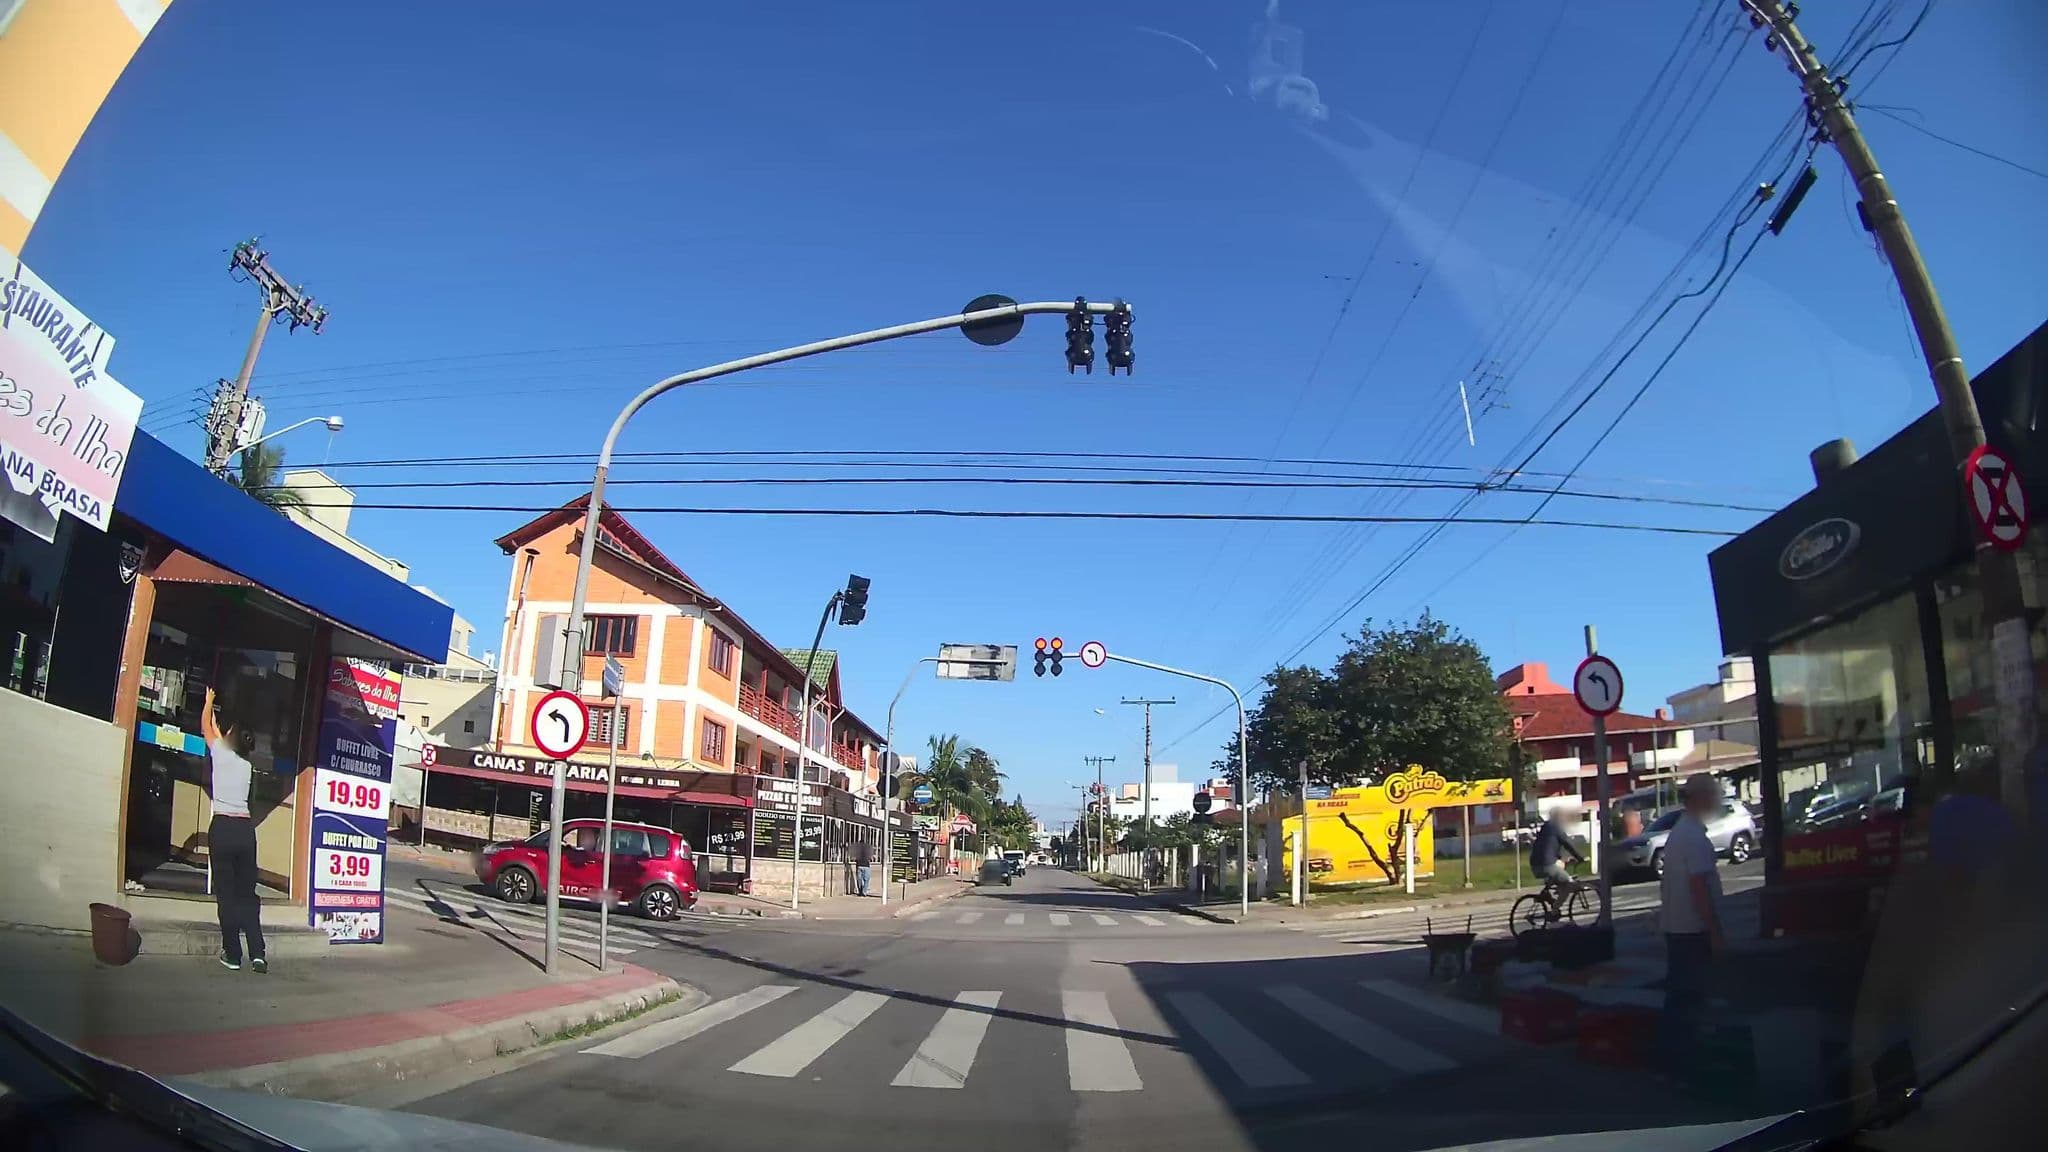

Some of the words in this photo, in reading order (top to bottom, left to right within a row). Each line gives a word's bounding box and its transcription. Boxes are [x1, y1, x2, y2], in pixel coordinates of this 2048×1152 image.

[0, 277, 96, 388] STAURANTE
[37, 394, 72, 446] da
[7, 451, 34, 483] NA
[40, 471, 101, 521] BRASA
[371, 683, 382, 698] da
[336, 738, 361, 755] BUFFET
[361, 745, 379, 760] LIVRE
[330, 754, 340, 768] C/
[341, 757, 381, 777] CHURRASCO
[474, 754, 526, 772] CANAS
[534, 761, 608, 781] PIZARIA
[327, 780, 380, 810] 19,99
[757, 790, 783, 801] PIZZAS
[784, 793, 790, 803] E
[791, 795, 822, 807] MSSAS
[322, 832, 347, 847] BUFFET
[330, 854, 370, 877] 3,99
